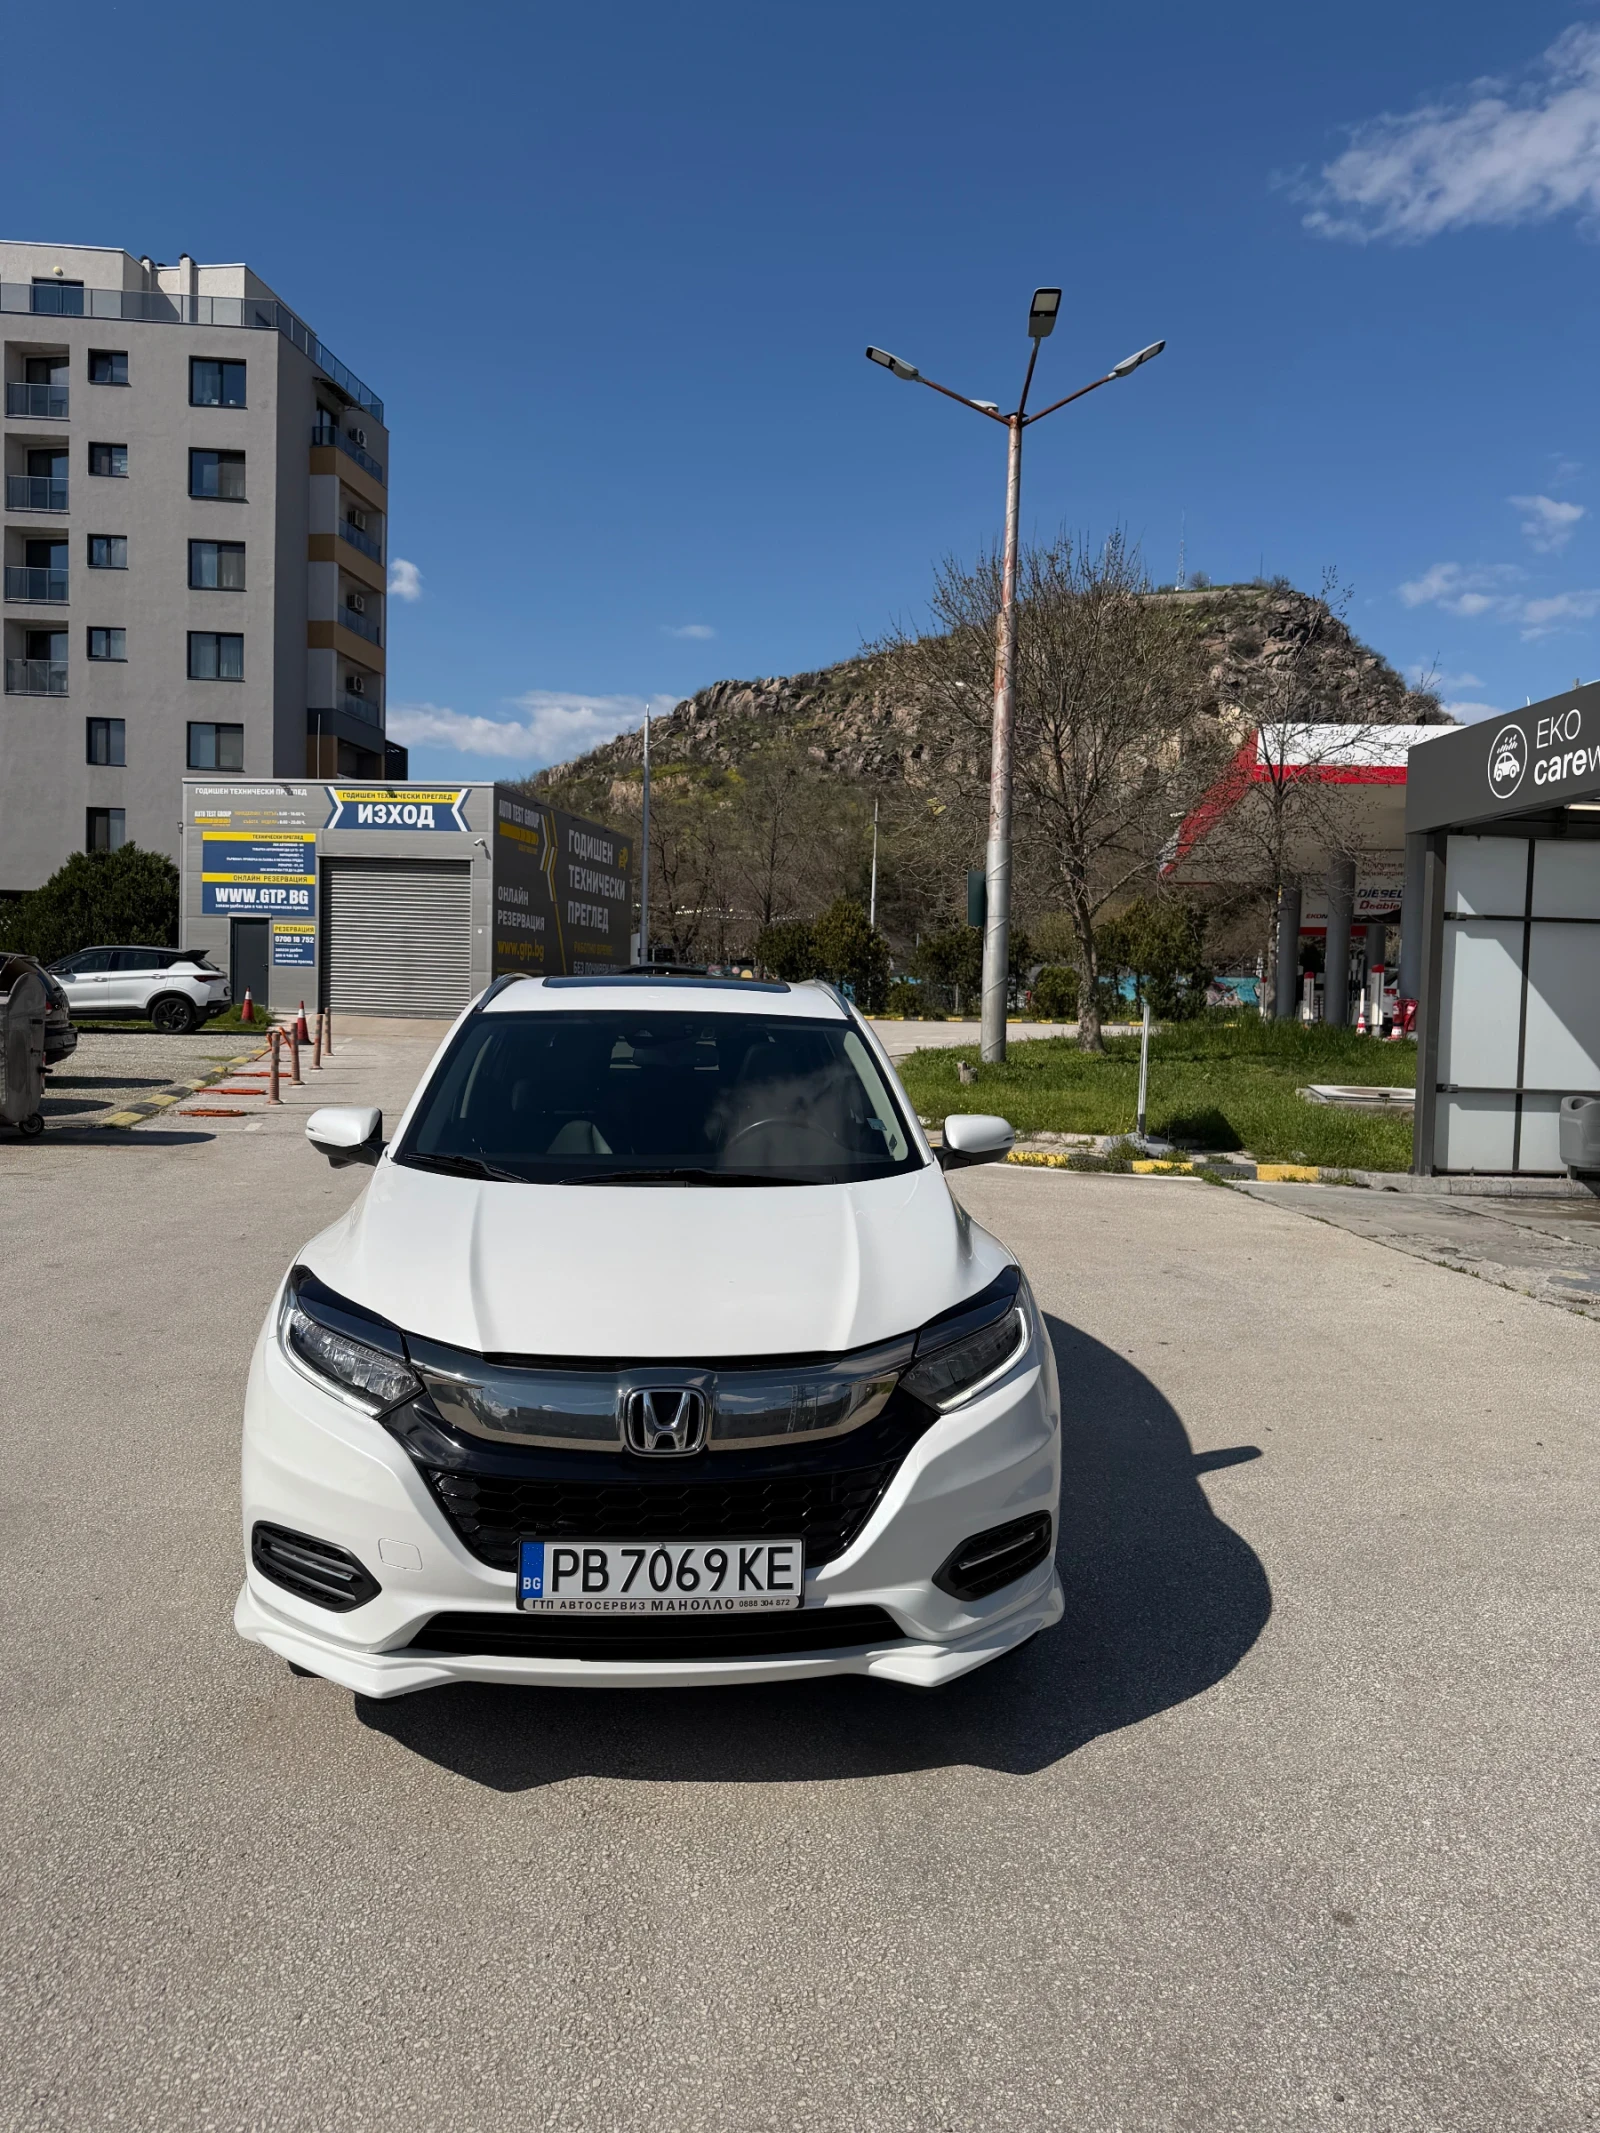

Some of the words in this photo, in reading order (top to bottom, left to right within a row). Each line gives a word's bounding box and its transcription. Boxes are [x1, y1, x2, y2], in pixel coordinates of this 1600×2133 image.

[1537, 709, 1581, 749] EKO
[358, 804, 435, 828] ИЗХОД
[568, 829, 613, 865] ГОДИШЕН
[568, 864, 625, 901] ТЕХНИЧЕСКИ
[215, 887, 309, 904] WWW.GTP.BG
[498, 886, 528, 906] ОНЛАЙН
[498, 910, 544, 932] РЕЗЕРВАЦИЯ
[568, 900, 609, 934] ПРЕГЛЕД
[497, 939, 544, 962] www.gtp.bg
[552, 1548, 610, 1593] PB
[620, 1547, 728, 1593] 7069
[738, 1546, 793, 1592] KE
[523, 1577, 541, 1590] BG
[532, 1600, 554, 1609] ГТП
[560, 1600, 645, 1610] АВТОСЕРВИЗ
[651, 1599, 734, 1611] МАНОЛЛО
